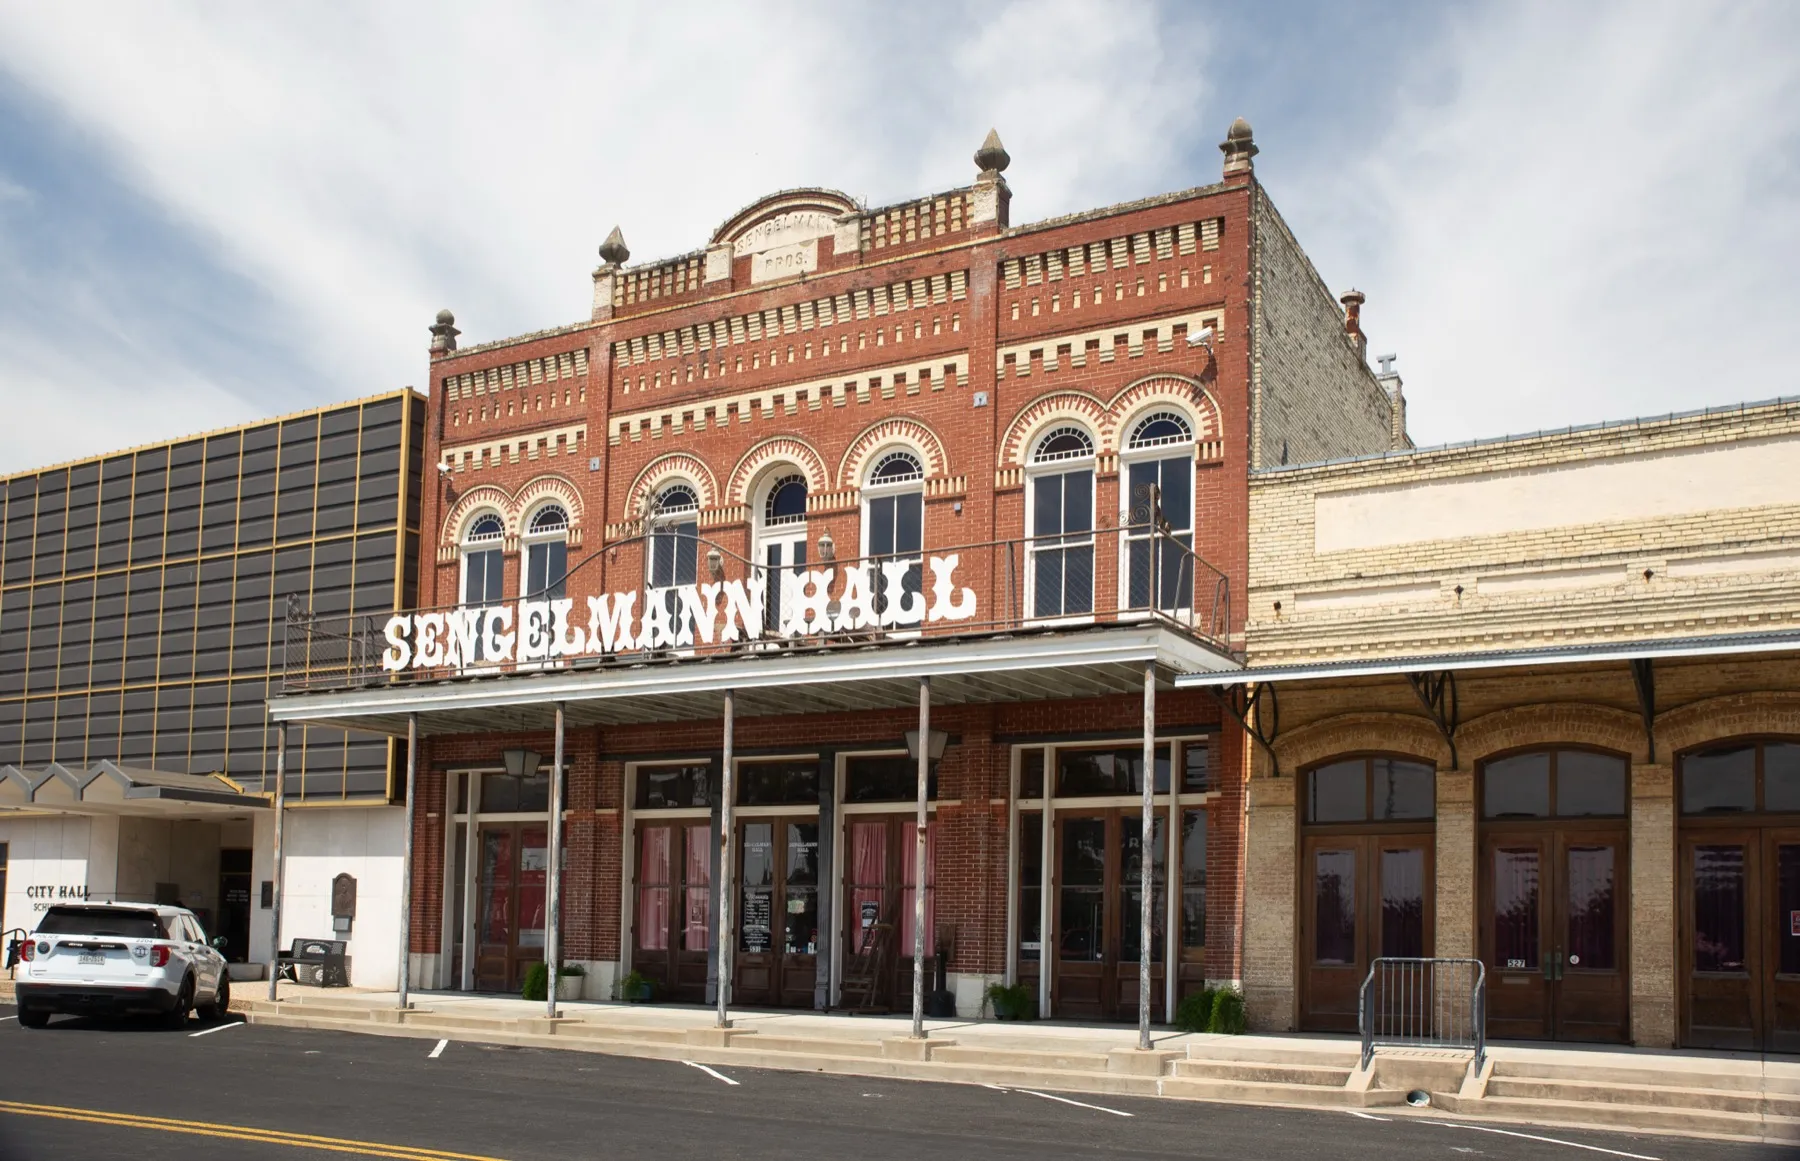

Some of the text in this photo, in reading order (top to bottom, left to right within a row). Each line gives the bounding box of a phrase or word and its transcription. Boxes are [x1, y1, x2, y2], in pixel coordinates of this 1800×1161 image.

[383, 554, 977, 671] SENGELMANN HALL
[27, 885, 91, 899] CITY HALL
[1508, 959, 1525, 968] 527
